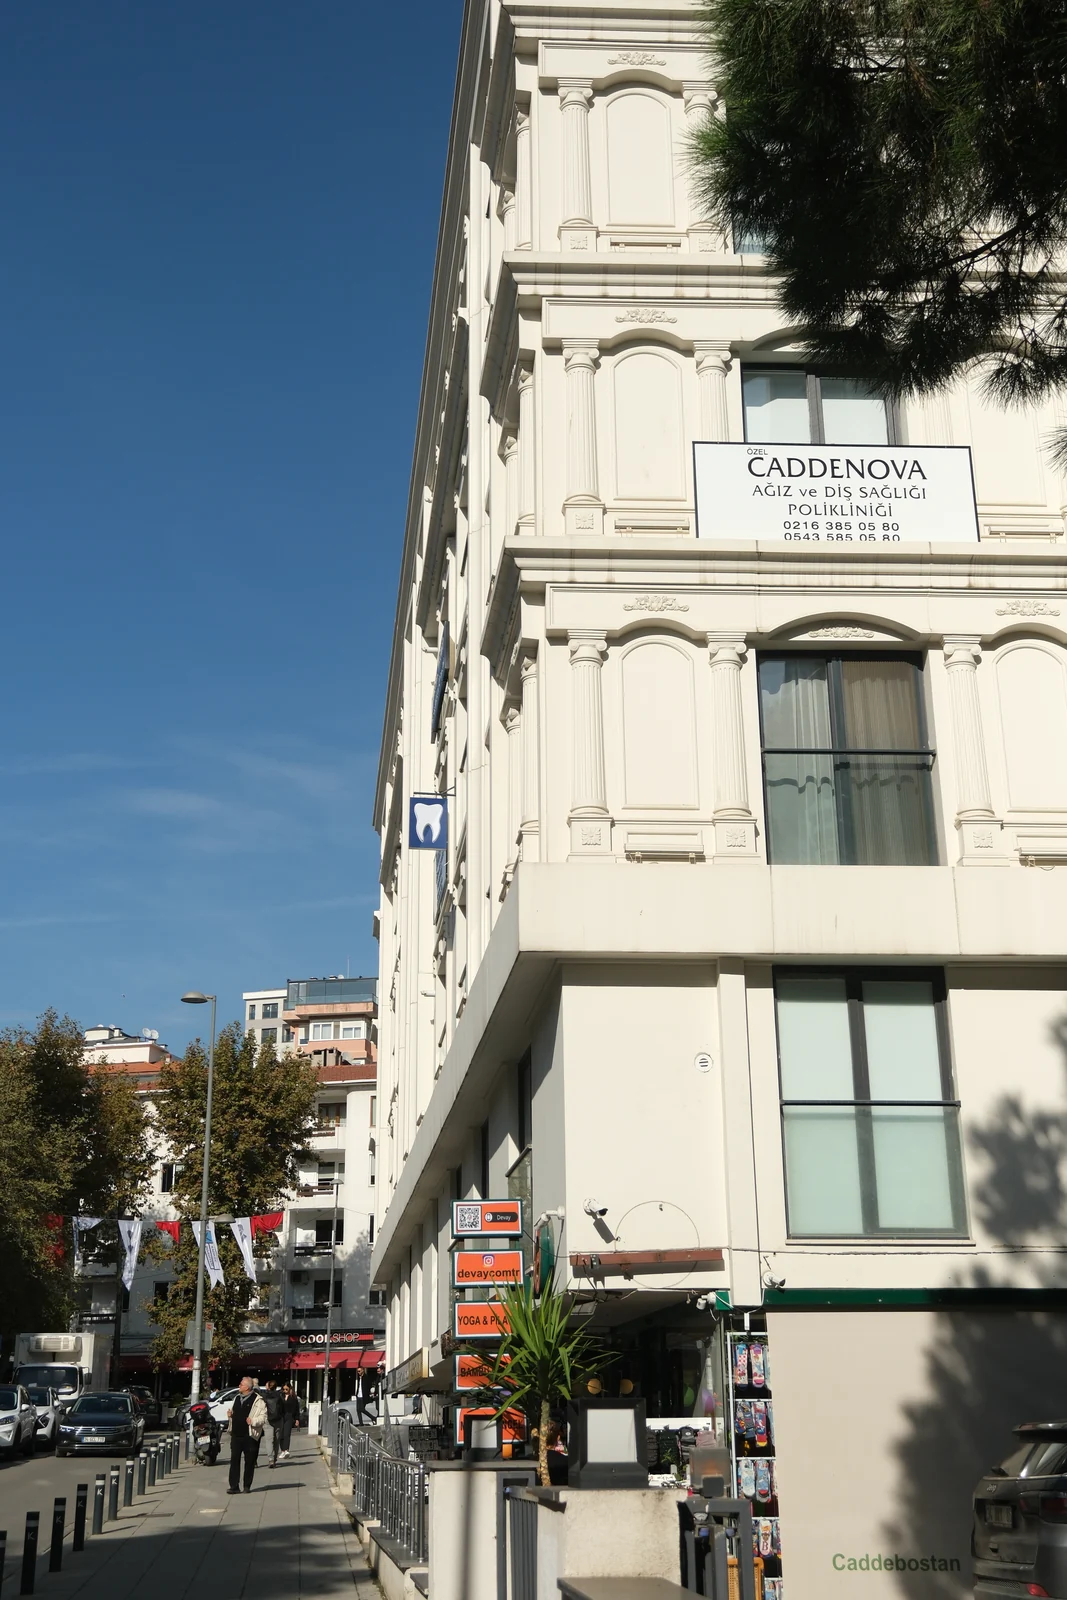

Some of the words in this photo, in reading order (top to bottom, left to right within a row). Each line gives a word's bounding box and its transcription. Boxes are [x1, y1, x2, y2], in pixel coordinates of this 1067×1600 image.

[746, 447, 769, 456] ÖZEL
[747, 456, 928, 480] CADDENOVA
[752, 482, 793, 497] AĞIZ
[798, 488, 818, 498] ve
[824, 483, 853, 501] DİŞ
[859, 484, 927, 500] SAĞLIĞI
[788, 502, 893, 517] POLİKLİNİĞİ
[783, 520, 820, 530] 0216
[825, 521, 853, 531] 385
[858, 522, 876, 531] 05
[882, 522, 900, 532] 80
[784, 532, 820, 541] 0543
[826, 533, 853, 541] 585
[859, 533, 877, 541] 05
[882, 533, 901, 542] 80
[496, 1214, 512, 1222] Devay
[457, 1268, 520, 1279] devaycomtr
[458, 1315, 481, 1326] YOGA
[482, 1315, 489, 1325] &
[490, 1315, 509, 1325] PILA
[832, 1553, 961, 1572] Caddebostan
